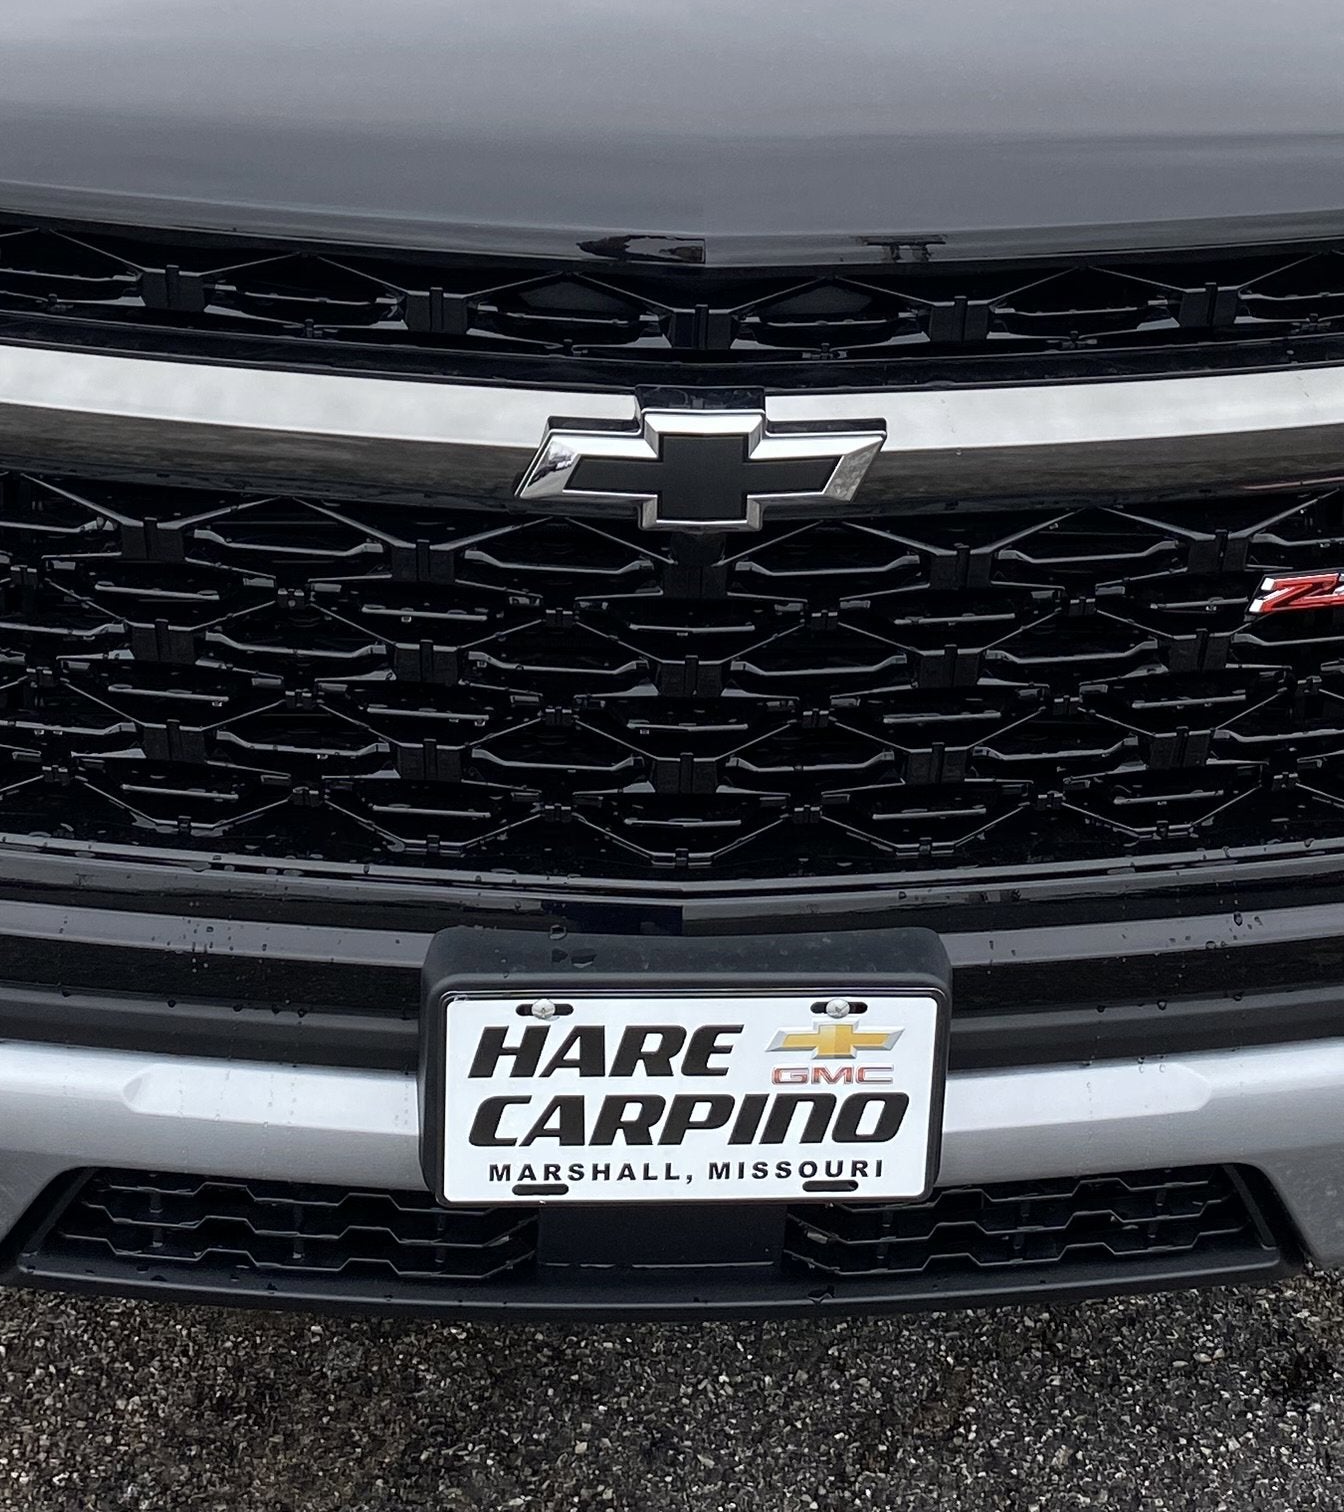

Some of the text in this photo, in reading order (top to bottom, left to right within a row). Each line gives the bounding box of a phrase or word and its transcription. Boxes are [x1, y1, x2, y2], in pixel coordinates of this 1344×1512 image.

[467, 1024, 744, 1078] HARE
[771, 1064, 893, 1086] GMC
[468, 1092, 910, 1146] CARPINO
[489, 1159, 883, 1183] MARSHALL, MISSOURI
